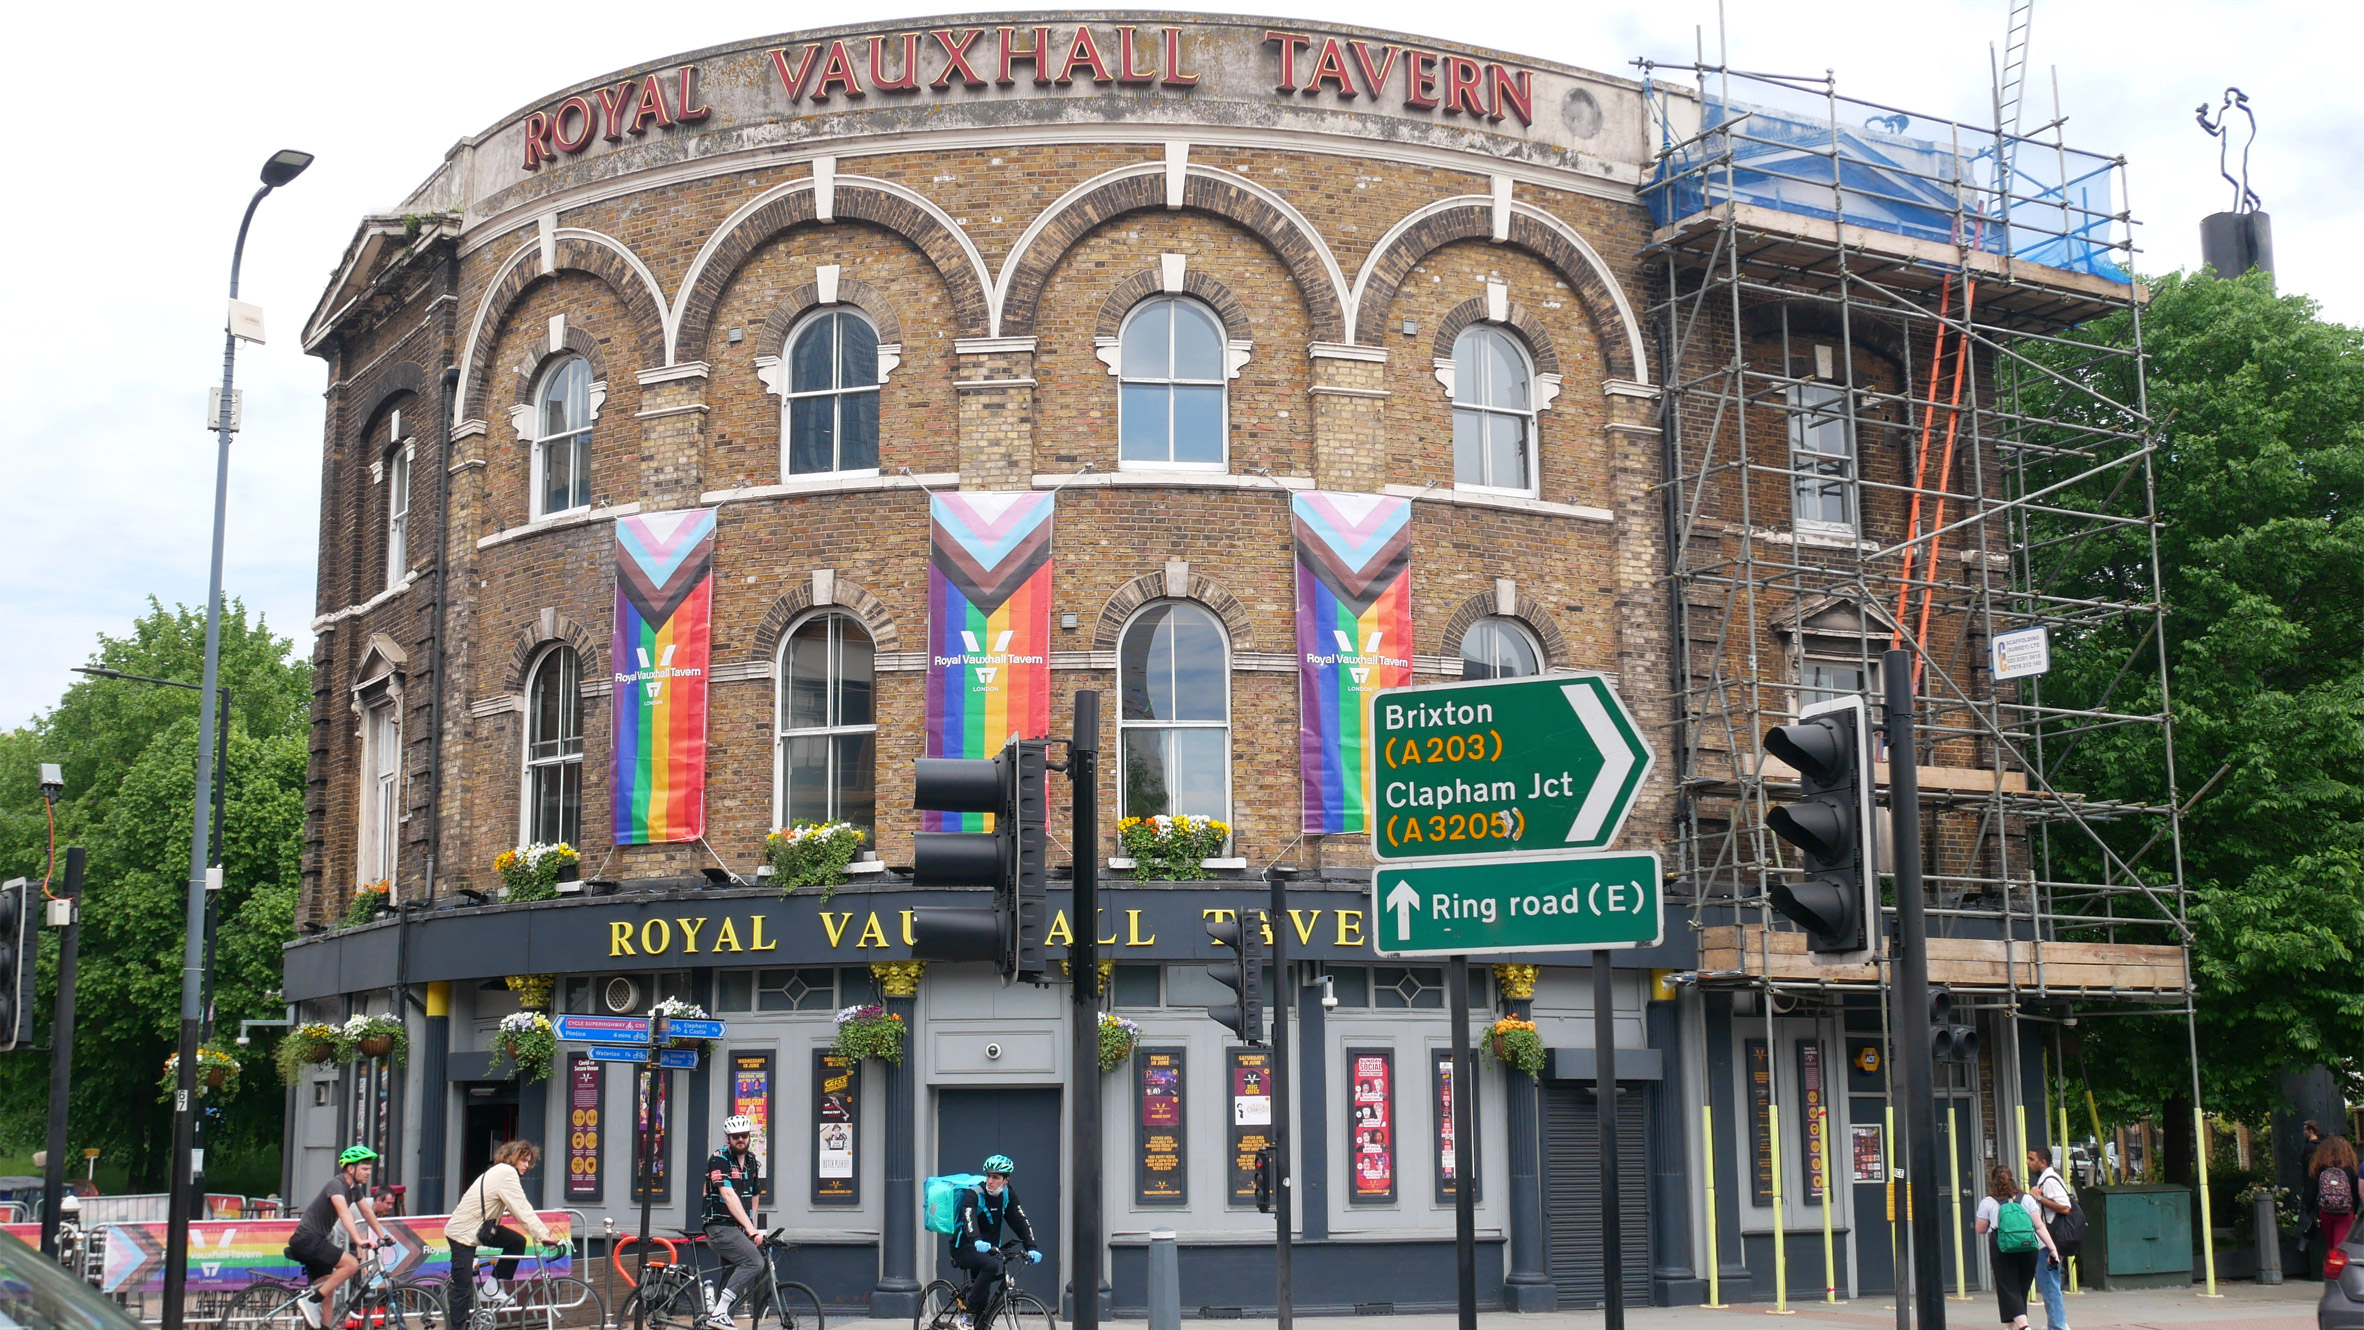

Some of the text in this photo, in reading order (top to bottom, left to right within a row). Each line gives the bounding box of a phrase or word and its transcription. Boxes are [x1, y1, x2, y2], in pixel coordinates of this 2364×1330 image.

[522, 25, 1533, 171] ROYAL VAUXHALL TAVERN
[2006, 635, 2039, 645] SCAFFOLDING
[934, 654, 1043, 667] Royal Vauxhall Tavern
[1306, 653, 1408, 667] Royal Vauxhall Tavern
[615, 667, 701, 684] Royal Vauxhall Tavern
[1386, 701, 1493, 730] Brixton
[1384, 729, 1503, 769] (A203)
[1386, 771, 1573, 810] Clapham Jct
[1386, 807, 1525, 847] (A3205)
[1432, 880, 1644, 923] Ring road (E)
[609, 915, 777, 957] ROYAL
[818, 908, 1156, 949] VAALL
[1359, 1063, 1382, 1071] SOCIAL
[191, 1249, 263, 1260] Vauxhall Tavern
[422, 1245, 449, 1256] Royal
